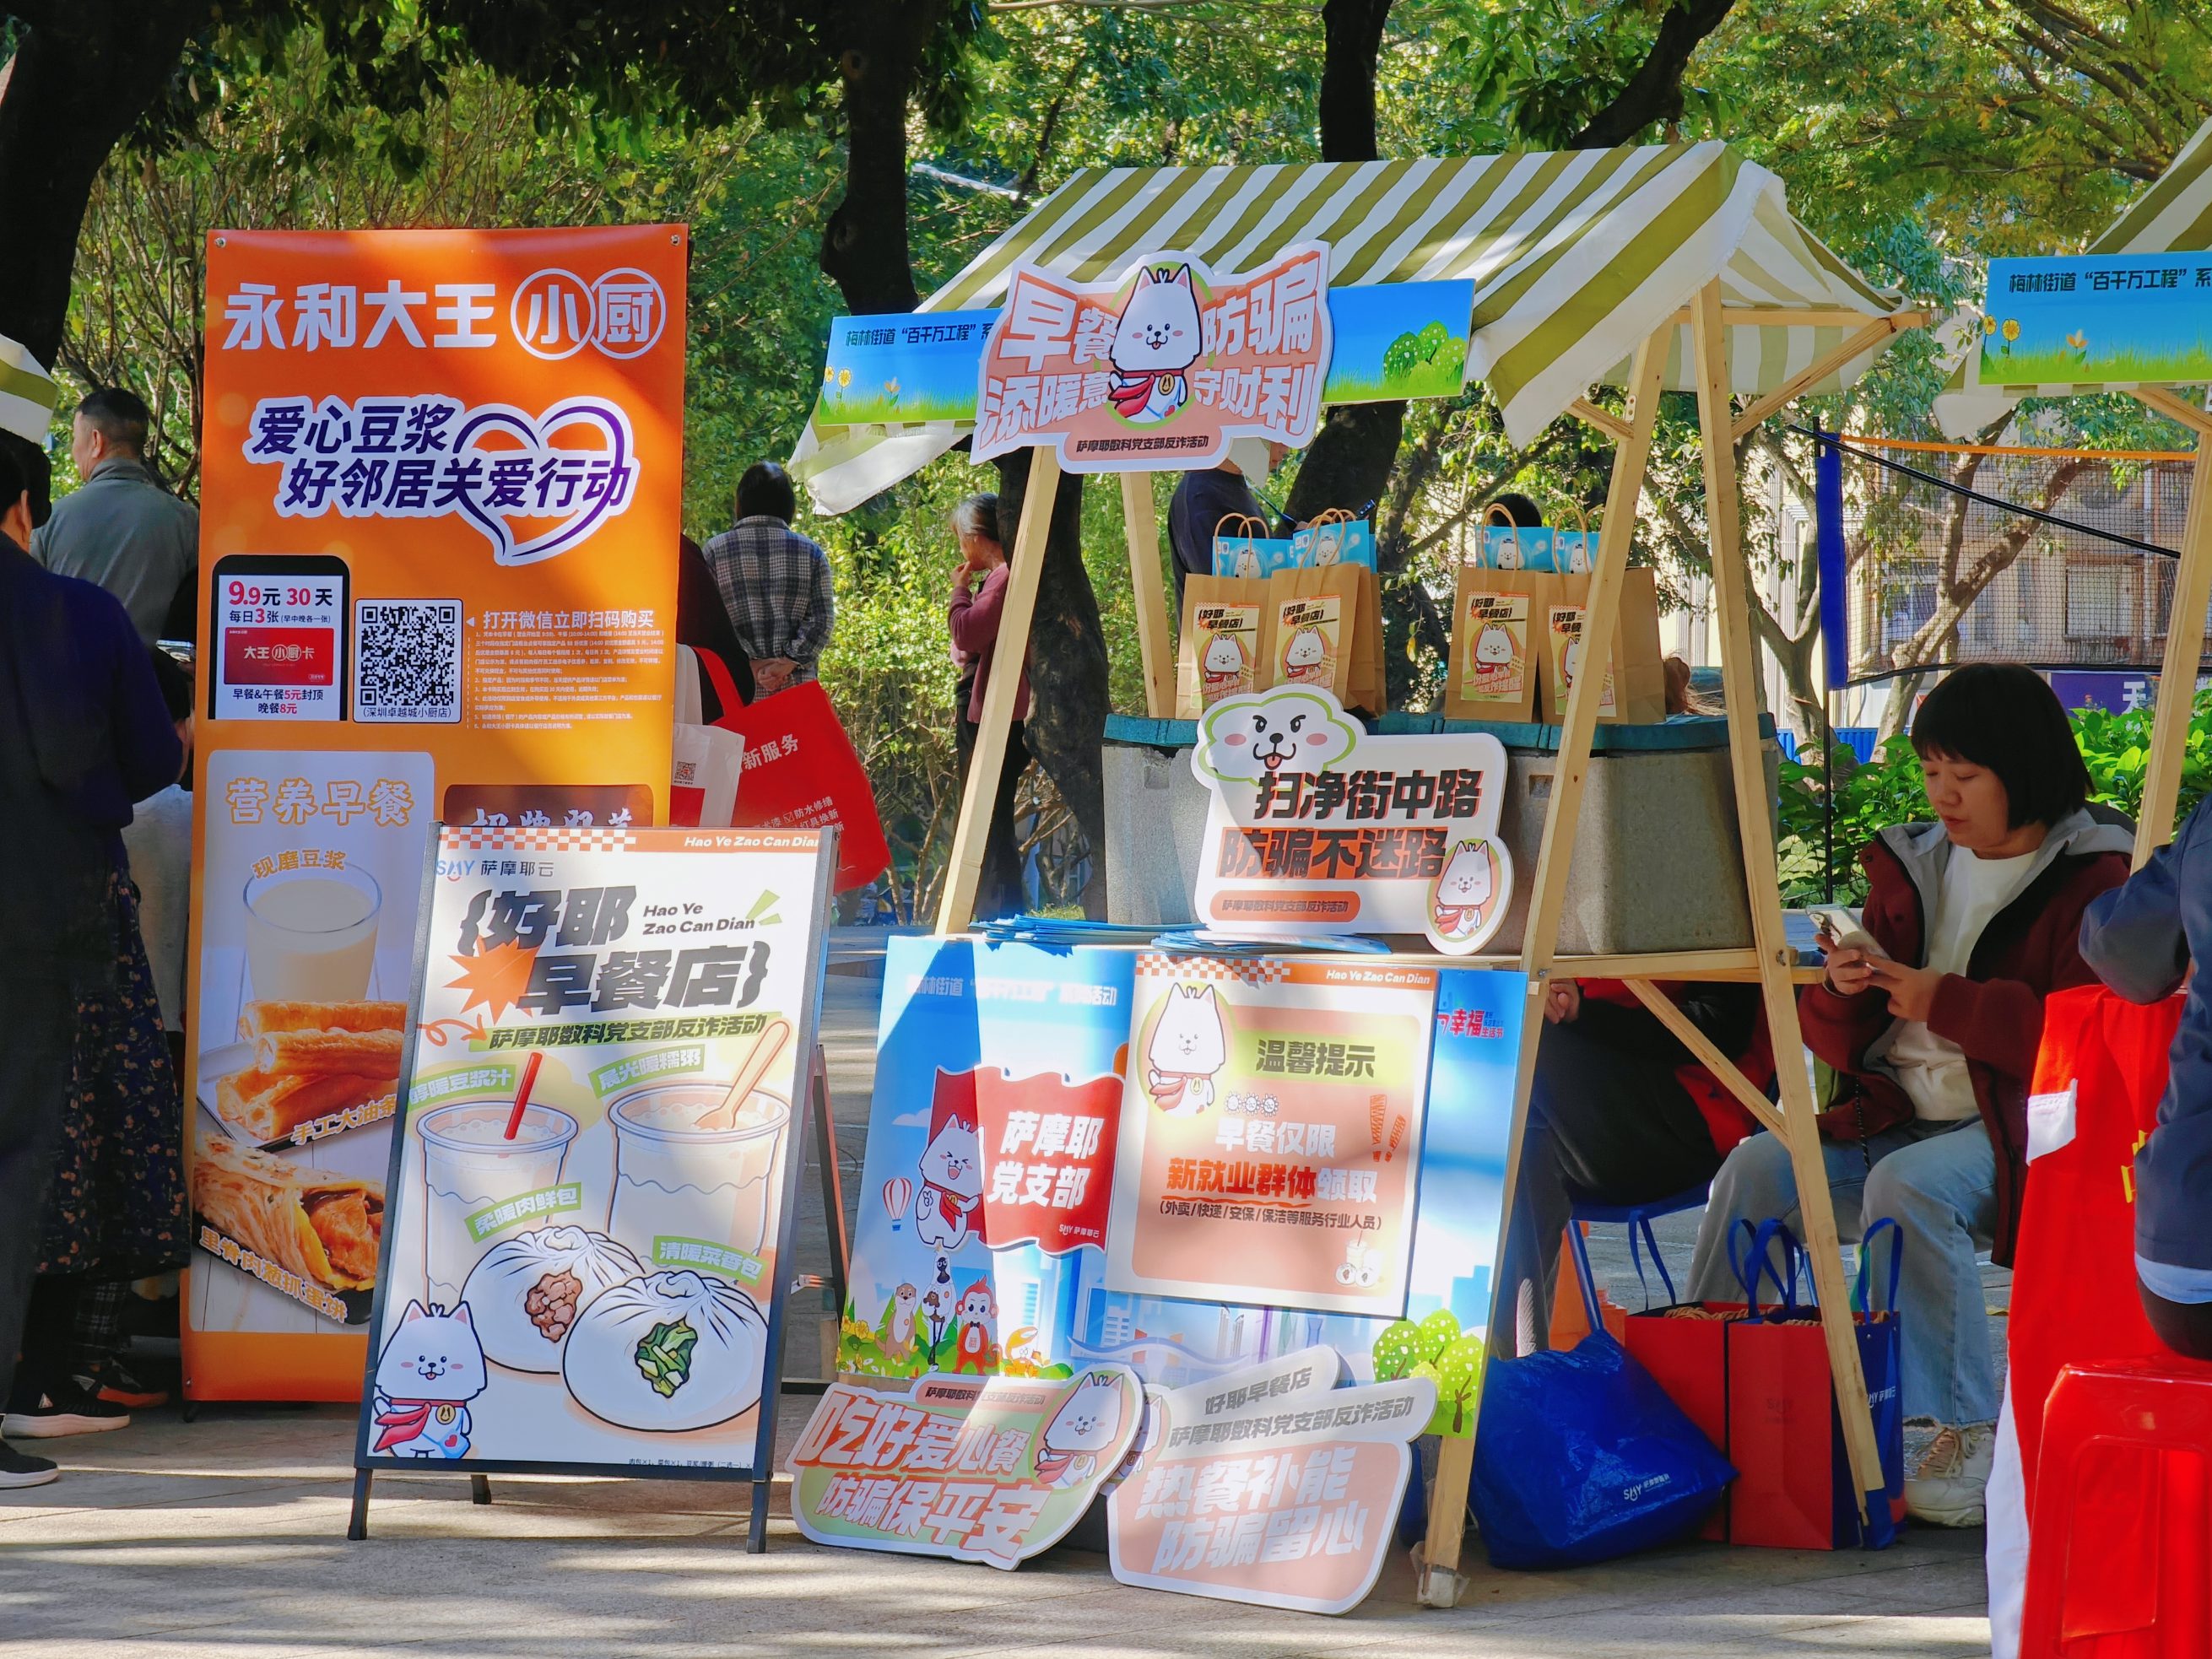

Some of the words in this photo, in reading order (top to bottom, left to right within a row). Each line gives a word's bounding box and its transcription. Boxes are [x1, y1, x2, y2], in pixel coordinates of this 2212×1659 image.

[2009, 272, 2076, 293] 梅林街道
[2085, 268, 2187, 290] “百千万工程”
[222, 280, 496, 351] 永和大王
[518, 275, 661, 353] 小厨
[998, 270, 1118, 373] 早餐
[1202, 251, 1320, 359] 防骗
[846, 328, 895, 347] 梅林街道
[901, 324, 976, 344] “百千万工程”
[251, 402, 457, 455] 爱心豆浆
[1076, 435, 1209, 452] 萨摩耶数科党支部反诈活动
[283, 457, 632, 510] 好邻居关爱行动
[229, 581, 280, 606] 9.9元
[229, 608, 279, 624] 每日3张
[484, 609, 654, 630] 打开微信立即扫码购买
[244, 645, 315, 661] 大王小厨卡
[233, 689, 323, 701] 早餐&午餐5元封顶
[257, 703, 297, 714] 晚餐8元
[363, 706, 452, 719] (深圳卓越城小厨店)
[740, 733, 798, 771] 新服务
[227, 776, 416, 830] 营养早餐
[1253, 769, 1485, 820] 扫净街中路
[684, 836, 712, 847] Hao
[716, 836, 732, 846] Ye
[733, 836, 760, 846] Zao
[763, 836, 790, 847] Can
[1218, 826, 1450, 879] 防骗不迷路
[251, 847, 345, 879] 现磨豆浆
[480, 859, 554, 878] 萨摩耶云
[643, 904, 680, 917] Hao
[683, 902, 704, 916] Ye
[643, 921, 677, 936] Zao
[679, 919, 714, 933] Can
[716, 916, 755, 932] Dian
[906, 975, 964, 997] 林街道
[1327, 969, 1347, 980] Hao
[1349, 970, 1362, 981] Ye
[1363, 971, 1383, 981] Zao
[1385, 972, 1406, 983] Can
[1407, 973, 1430, 985] Dian
[489, 1014, 767, 1050] 萨摩耶数科党支部反诈活动
[1256, 1039, 1376, 1078] 温馨提示
[1000, 1111, 1105, 1159] 萨摩耶
[1215, 1120, 1337, 1158] 早餐仅限
[987, 1160, 1090, 1209] 党支部
[1166, 1157, 1378, 1204] 新就业群体领取
[474, 1188, 580, 1235] 柔暖肉鲜包
[658, 1240, 763, 1283] 清暖菜香包
[1205, 1367, 1313, 1416] 好耶早餐店
[795, 1391, 1030, 1476] 吃好爱心餐
[1169, 1395, 1415, 1449] 萨摩耶数科党支部反诈活动
[1134, 1446, 1356, 1521] 热餐补能
[815, 1476, 1052, 1561] 防骗保平安
[1150, 1501, 1370, 1575] 防骗留心
